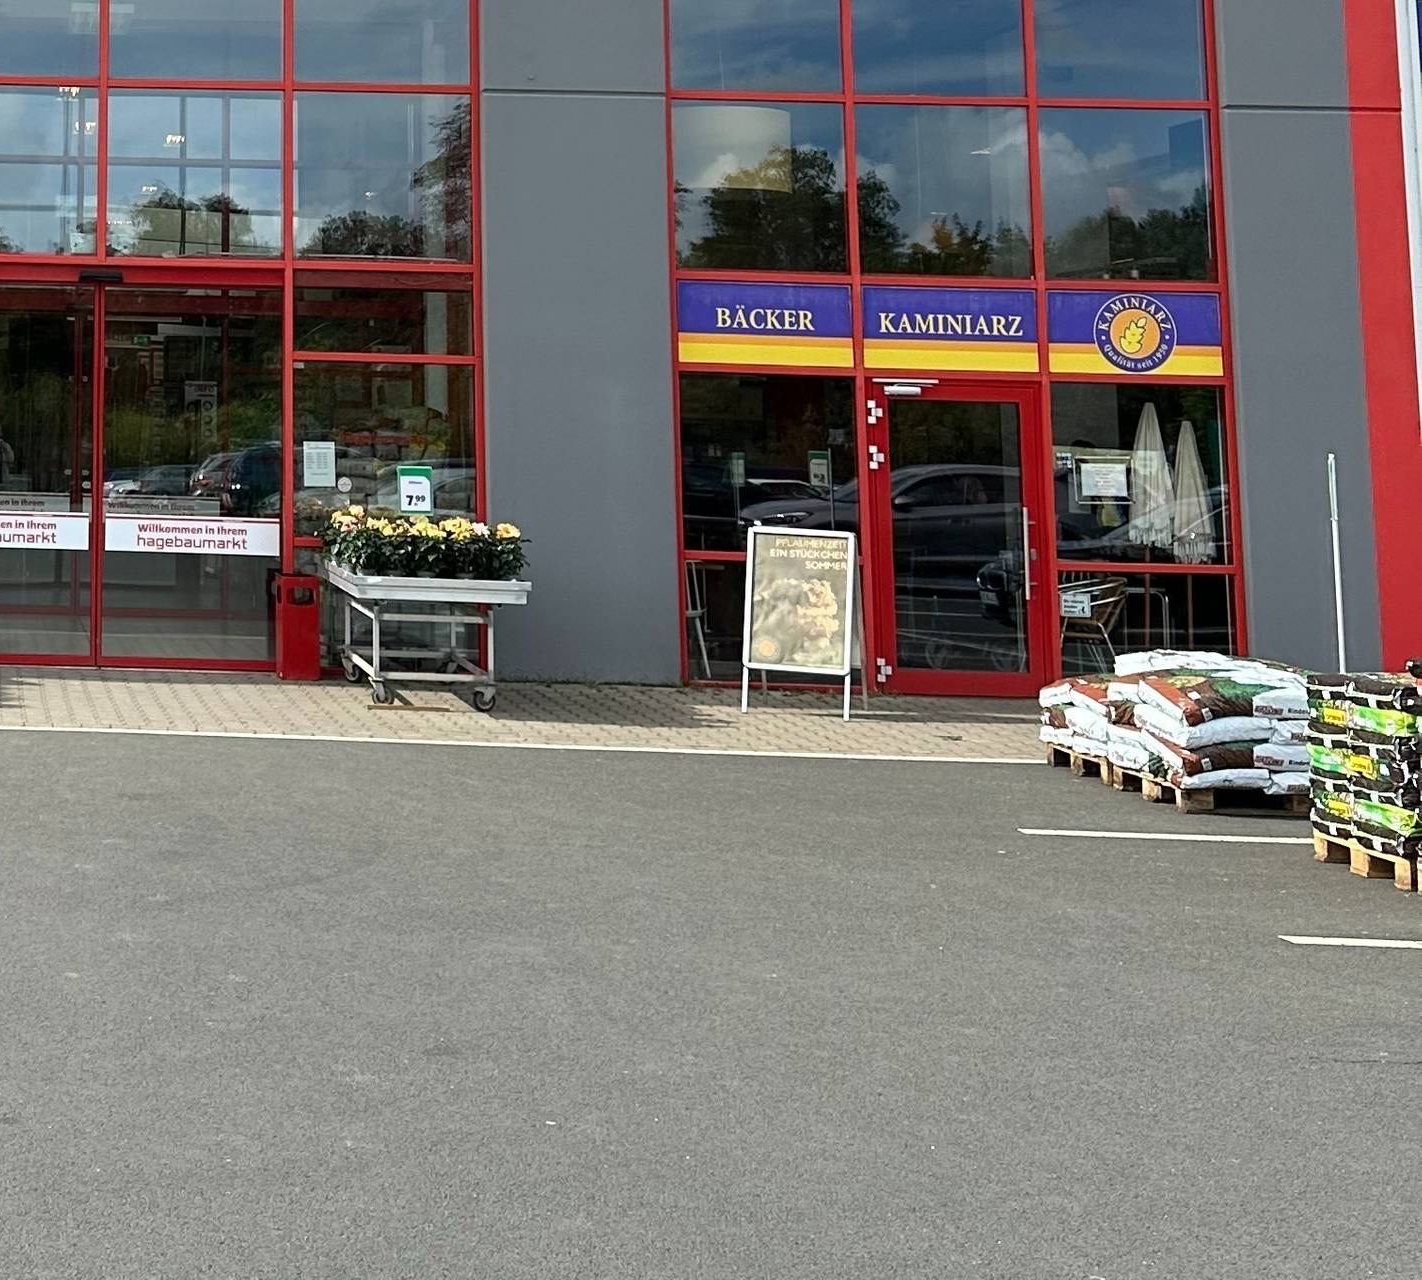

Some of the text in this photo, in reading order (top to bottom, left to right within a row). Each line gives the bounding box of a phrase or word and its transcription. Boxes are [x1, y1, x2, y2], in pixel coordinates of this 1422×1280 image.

[716, 305, 815, 331] BÄCKER
[1098, 297, 1172, 331] KAMINIARZ
[878, 312, 1024, 337] KAMINIARZ
[1104, 344, 1135, 369] Qualität
[1137, 360, 1153, 369] seit
[14, 519, 25, 529] in
[26, 520, 57, 530] Ihrem
[137, 523, 248, 536] Willkommen in Ihrem
[137, 534, 248, 550] hagebaumarkt
[770, 548, 787, 558] EIN
[805, 560, 847, 571] SOMMER
